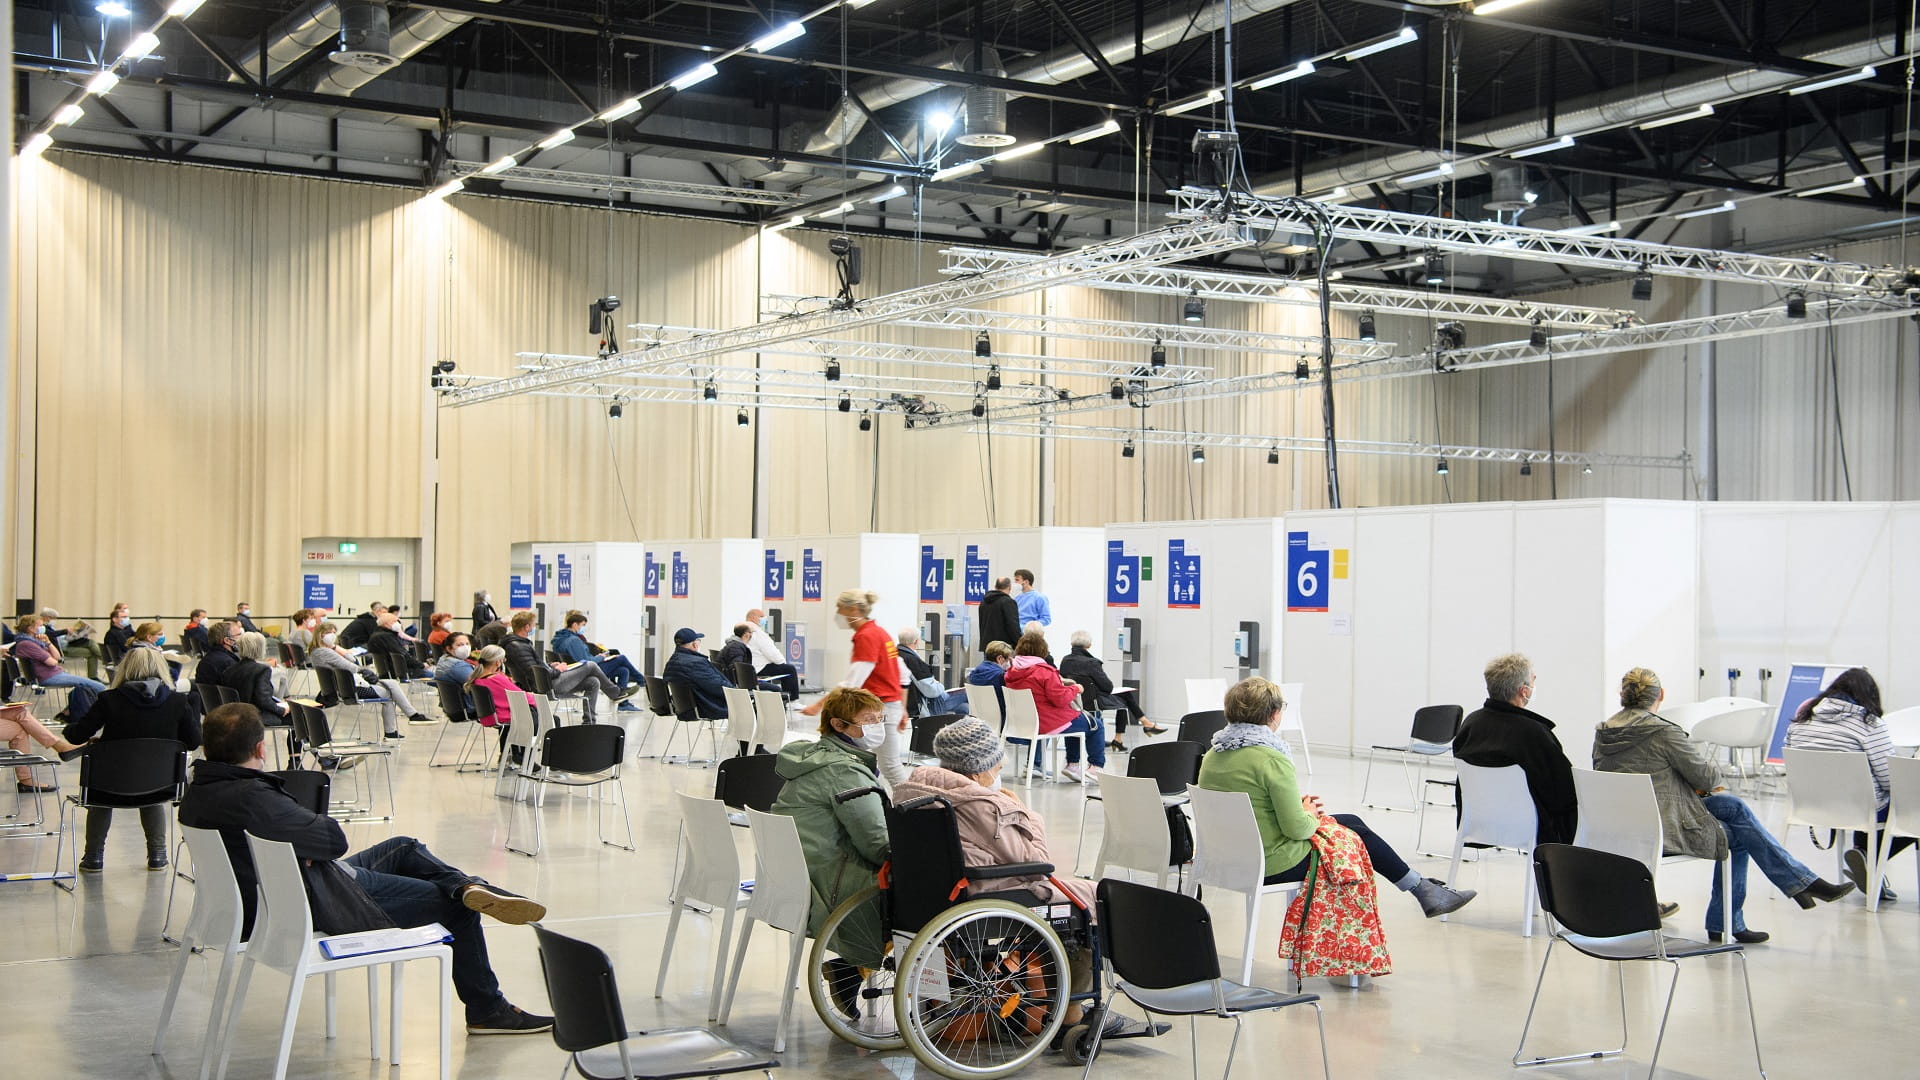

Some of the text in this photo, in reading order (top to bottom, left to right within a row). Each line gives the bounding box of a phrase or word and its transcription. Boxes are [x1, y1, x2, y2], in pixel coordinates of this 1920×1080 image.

[537, 569, 543, 589] 1
[647, 569, 656, 590] 2
[769, 568, 779, 591] 3
[925, 567, 939, 592] 4
[1115, 565, 1130, 595] 5
[1297, 560, 1318, 597] 6
